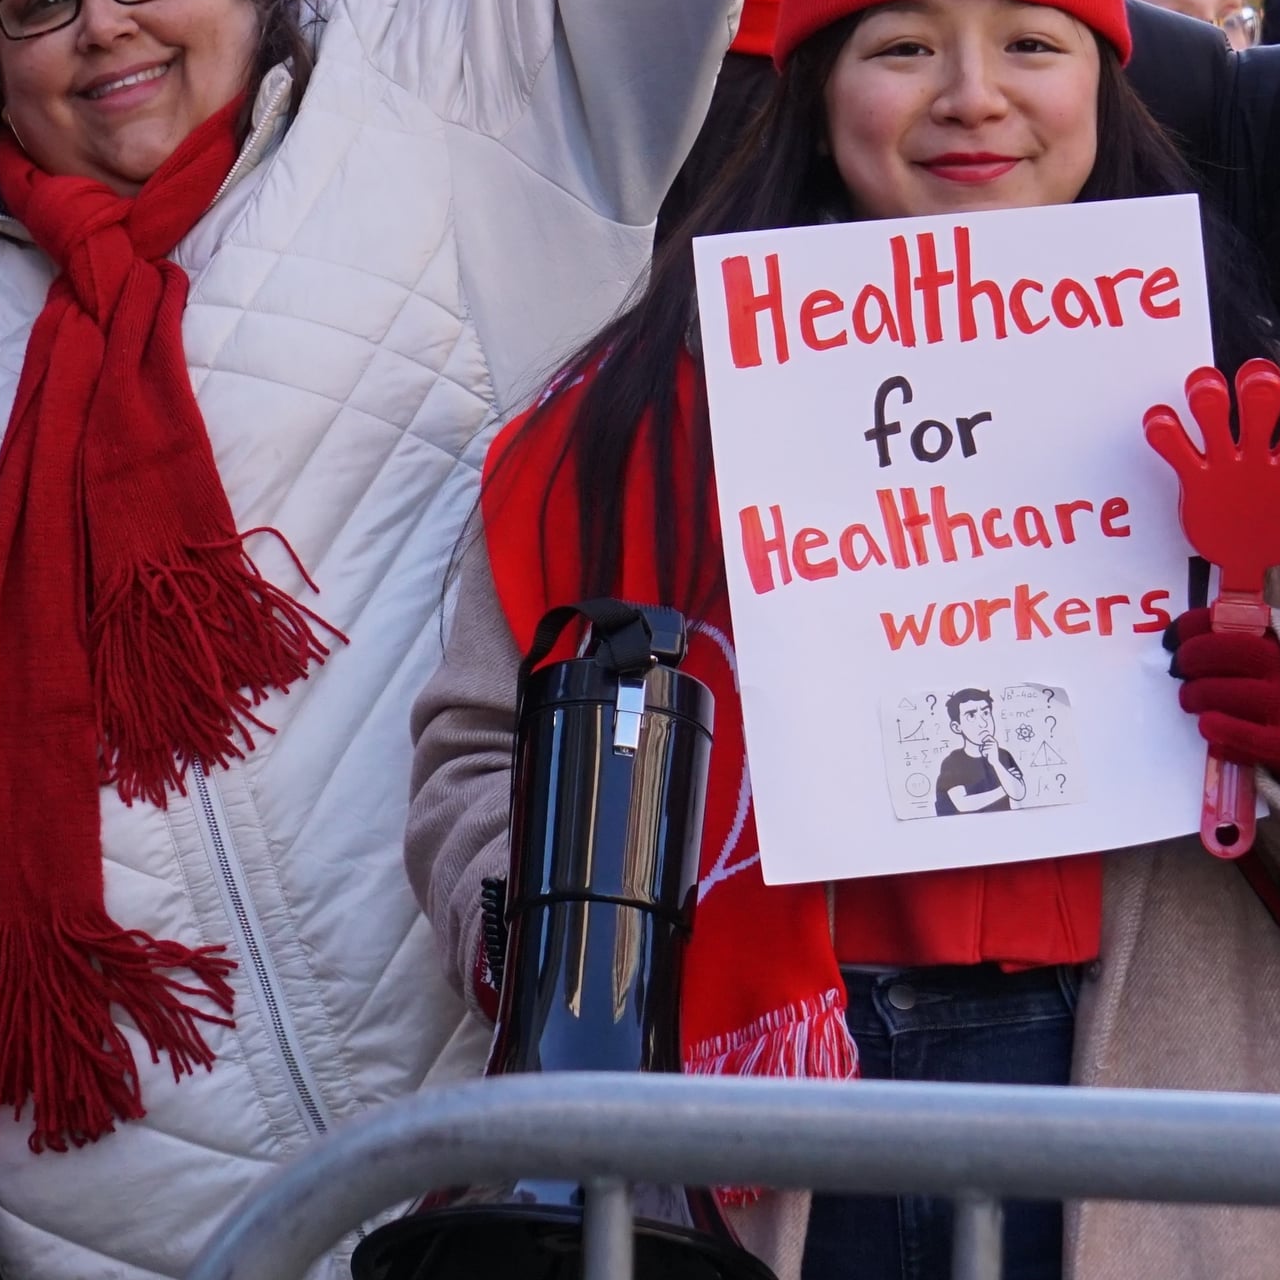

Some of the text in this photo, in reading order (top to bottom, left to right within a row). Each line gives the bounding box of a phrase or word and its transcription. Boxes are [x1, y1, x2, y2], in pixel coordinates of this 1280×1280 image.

[721, 226, 1184, 368] Healthcare
[864, 375, 993, 468] for
[739, 485, 1131, 595] Healthcare
